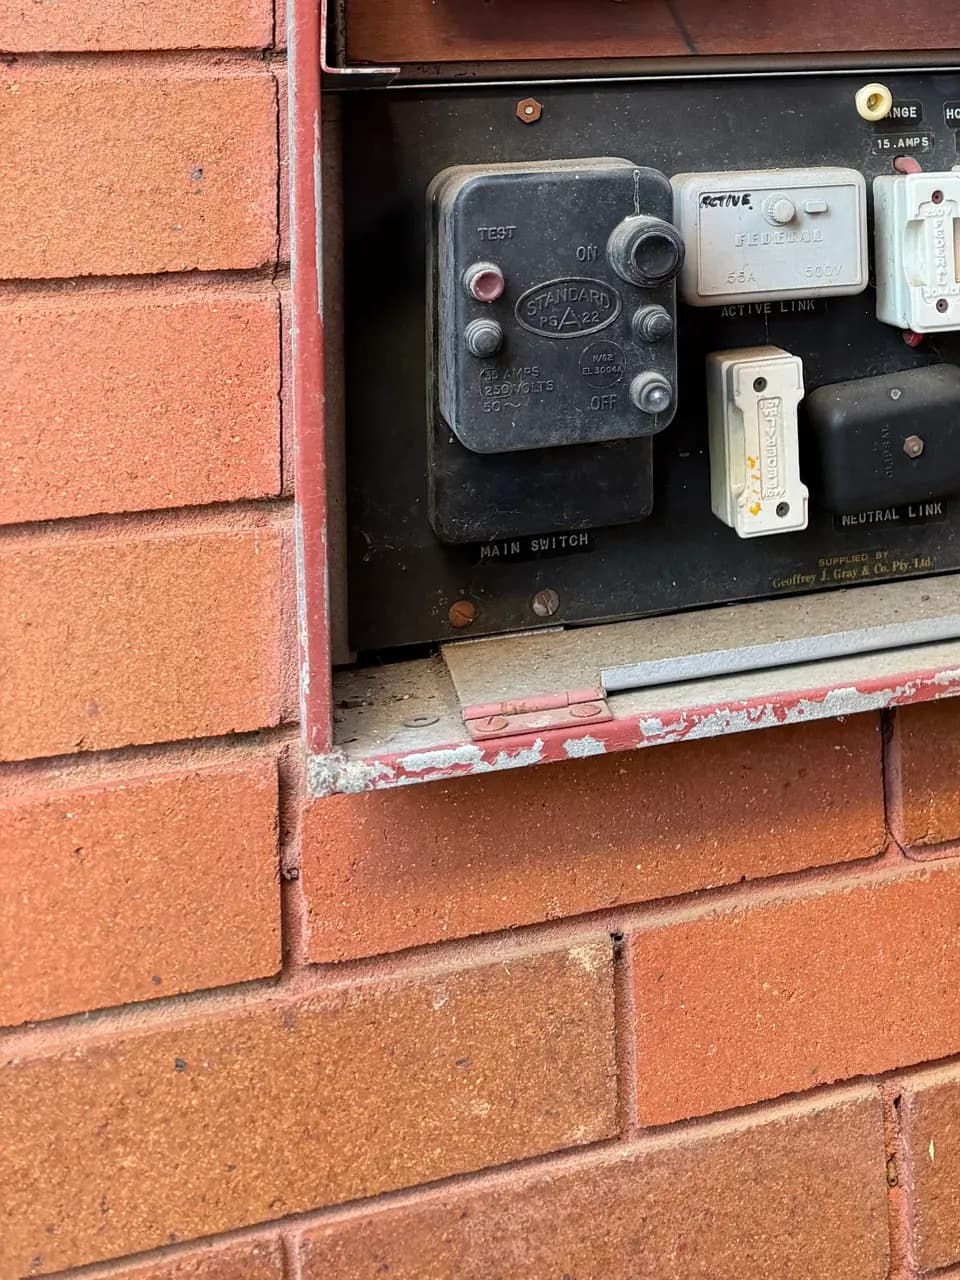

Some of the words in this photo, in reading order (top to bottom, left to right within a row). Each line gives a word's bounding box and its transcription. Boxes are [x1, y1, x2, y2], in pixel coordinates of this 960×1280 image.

[885, 106, 918, 119] ANGE
[477, 225, 517, 241] TEST
[735, 228, 824, 248] FEDERAL
[576, 244, 598, 262] ON
[527, 287, 611, 316] STANDARD
[721, 302, 772, 318] ACTIVE
[781, 300, 816, 314] LINK
[503, 366, 541, 382] AMPS
[484, 383, 511, 396] 250
[513, 380, 555, 395] VOLTS
[590, 393, 618, 411] OFF
[767, 417, 779, 489] FEDERAL
[842, 508, 900, 527] NEUTRAL
[908, 502, 943, 518] LINK
[480, 541, 520, 558] MAIN
[530, 532, 589, 552] SWITCH
[818, 552, 869, 568] SUPPLIED
[876, 551, 889, 560] BY
[772, 573, 817, 590] Geoffrey
[820, 569, 830, 581] J.
[833, 567, 858, 579] Gray
[861, 565, 869, 575] &
[892, 559, 912, 572] Pty.
